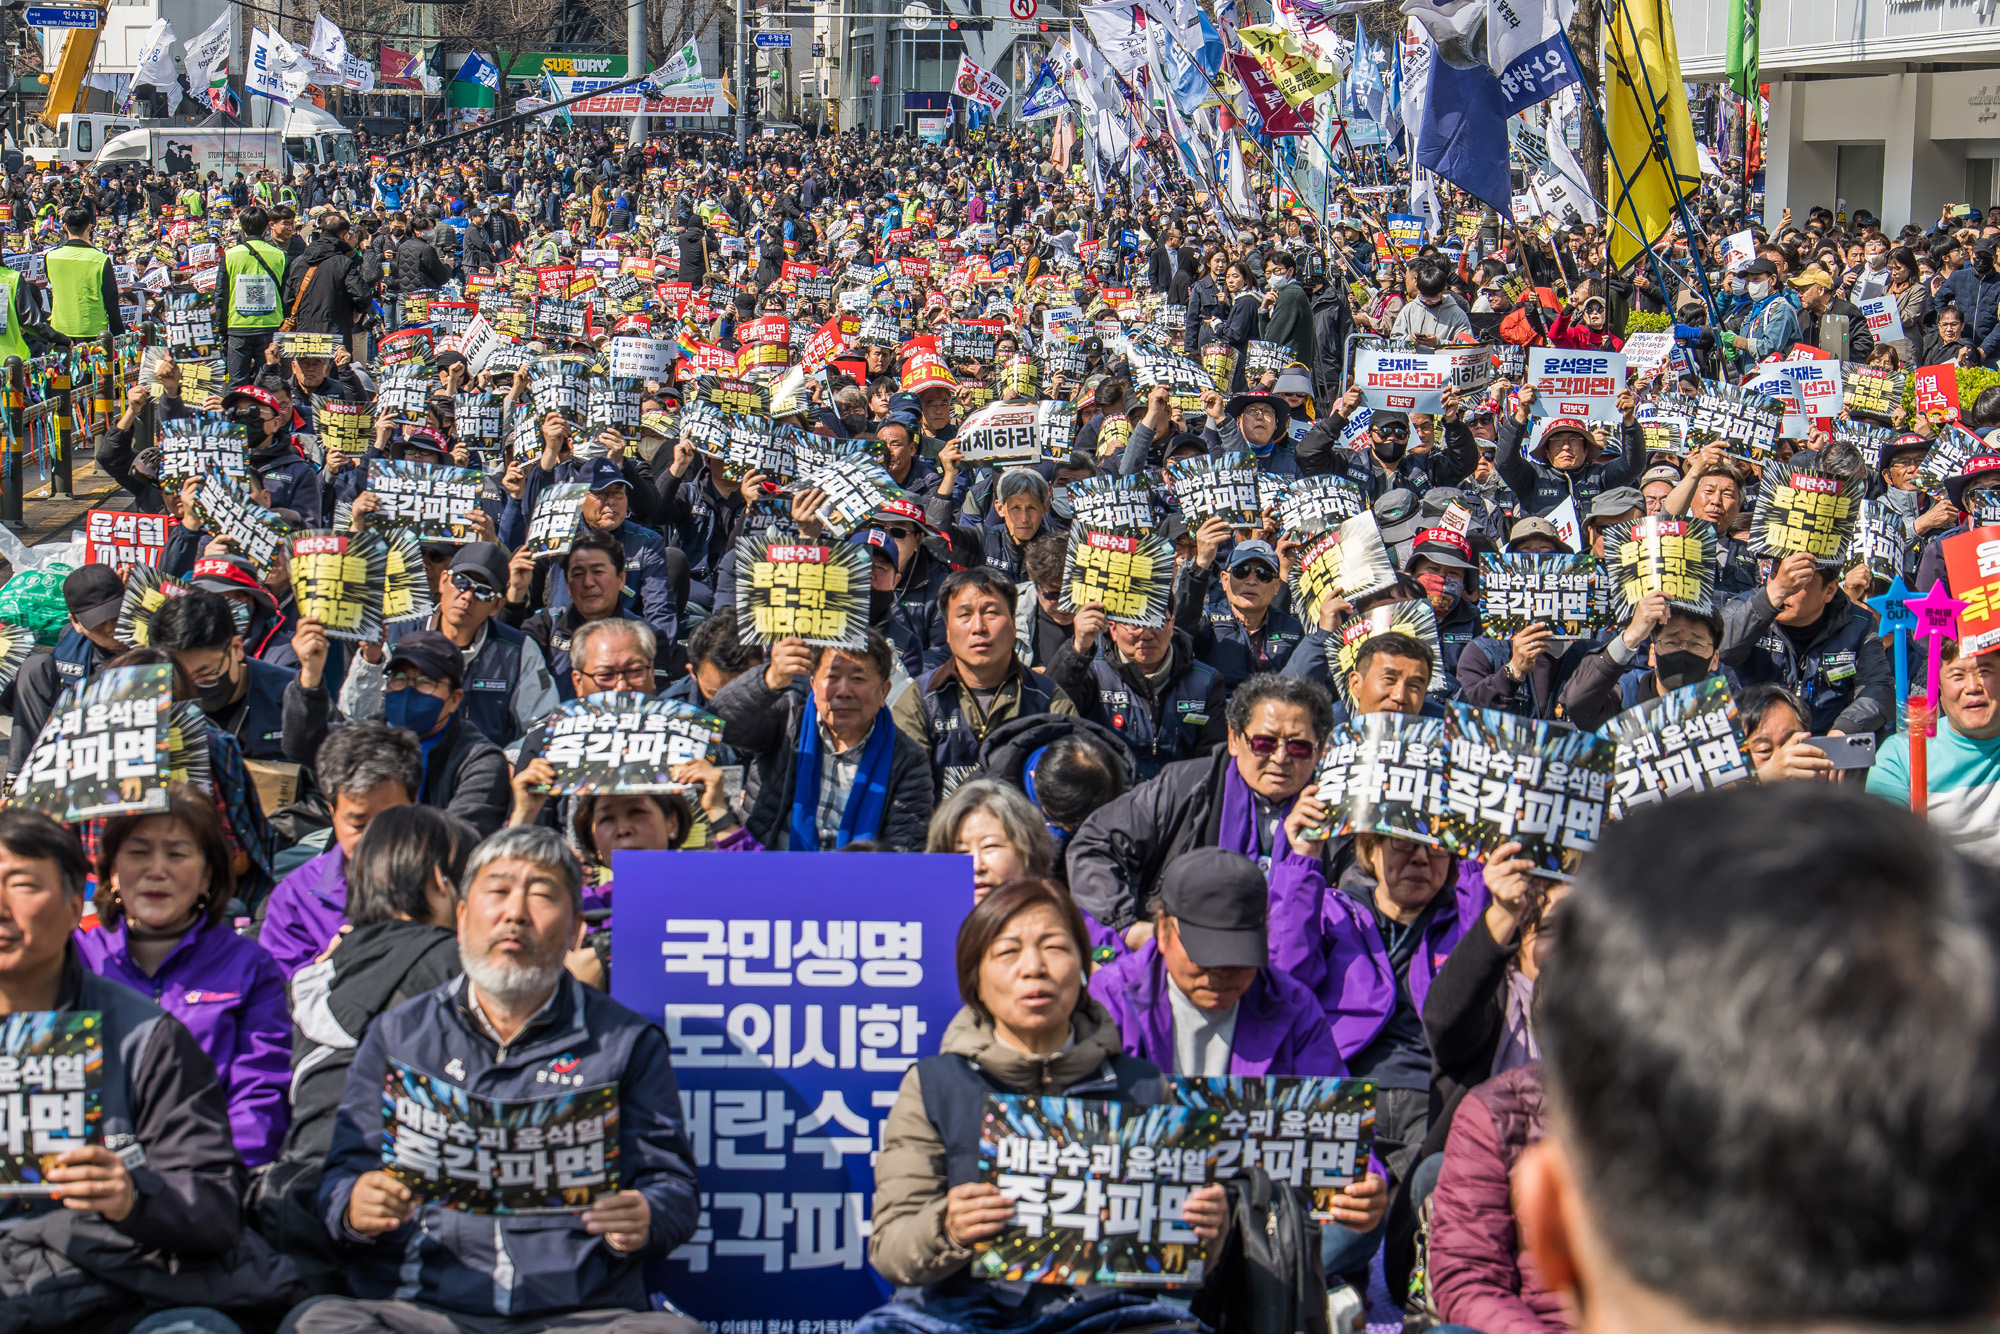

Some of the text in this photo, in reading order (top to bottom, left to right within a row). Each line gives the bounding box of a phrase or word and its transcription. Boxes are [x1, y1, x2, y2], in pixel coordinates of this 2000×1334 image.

[63, 11, 94, 20] 인사동길
[544, 58, 609, 72] SUBWAY
[644, 97, 714, 112] 완전청산!
[798, 288, 831, 298] 즉각파면
[176, 308, 211, 323] 윤석열
[539, 311, 583, 329] 즉각파면
[540, 306, 588, 317] 내란수괴 윤석열
[740, 324, 786, 340] 윤석열 파면
[691, 356, 737, 367] 새나라로
[803, 341, 835, 366] 새나라로
[953, 347, 994, 359] 즉각파면
[1378, 358, 1428, 371] 헌재는
[1544, 358, 1608, 375] 윤석열은
[1860, 368, 1883, 377] 내란수괴
[396, 378, 427, 390] 윤석열
[723, 382, 749, 392] 내란수괴
[902, 369, 927, 387] 즉각
[1136, 365, 1213, 390] 즉각파면
[1368, 373, 1442, 388] 파면선고!
[1537, 377, 1615, 395] 즉각파면!
[1849, 374, 1894, 392] 윤석열을
[329, 404, 358, 413] 내란수괴
[469, 407, 499, 417] 윤석열
[535, 388, 588, 416] 즉각파면
[1389, 397, 1412, 407] 진보당
[1562, 404, 1587, 415] 진보당
[1699, 396, 1779, 427] 내란수괴 윤석열
[1844, 393, 1890, 412] 파면하라
[320, 411, 373, 429] 윤석열을
[731, 428, 772, 448] 내란수괴
[1694, 411, 1776, 451] 즉각파면
[205, 437, 243, 452] 윤석열
[729, 441, 794, 476] 즉각파면
[374, 477, 476, 500] 내란수괴 윤석열
[1174, 468, 1255, 494] 내란수괴 윤석열
[1795, 476, 1838, 493] 내란수괴
[206, 474, 279, 547] 내란수괴 윤석열
[378, 493, 475, 526] 즉각파면
[539, 499, 577, 520] 윤석열
[1073, 490, 1117, 512] 내란수괴
[1180, 486, 1258, 520] 즉각파면
[1773, 484, 1852, 519] 윤석열을
[1077, 503, 1153, 530] 즉각파면
[1282, 497, 1362, 530] 즉각파면
[88, 512, 165, 546] 윤석열
[200, 486, 273, 566] 즉각파면
[295, 537, 340, 553] 내란수괴
[1091, 533, 1130, 549] 내란수괴
[1765, 522, 1842, 555] 파면하라
[771, 546, 821, 561] 내란수괴
[1075, 544, 1154, 580] 윤석열을
[204, 560, 228, 574] 투쟁
[753, 562, 850, 594] 윤석열을
[1486, 574, 1589, 590] 내란수괴 윤석열
[1071, 582, 1148, 616] 파면하라
[1486, 591, 1589, 620] 즉각파면
[1886, 600, 1908, 609] 윤석
[754, 607, 847, 636] 파면하라
[1887, 608, 1910, 620] OUT
[1924, 607, 1952, 617] 윤석열
[1928, 617, 1948, 627] 파면
[86, 698, 158, 732] 윤석열
[554, 713, 711, 744] 내란수괴 윤석열
[1660, 708, 1734, 748] 윤석열
[544, 732, 708, 768] 즉각파면
[1322, 739, 1401, 770] 내란수괴
[1450, 737, 1608, 799] 내란수괴 윤석열
[1445, 769, 1605, 852] 즉각파면
[662, 918, 924, 988] 국민생명
[664, 1002, 927, 1072] 도외시한
[0, 1054, 86, 1090] 윤석열
[396, 1096, 605, 1150] 내란수괴 윤석열
[1279, 1110, 1361, 1140] 윤석열
[393, 1124, 606, 1190] 즉각파면
[996, 1136, 1208, 1182] 내란수괴 윤석열
[998, 1174, 1200, 1243] 즉각파면
[721, 1319, 763, 1334] 이태원
[766, 1319, 794, 1334] 참사
